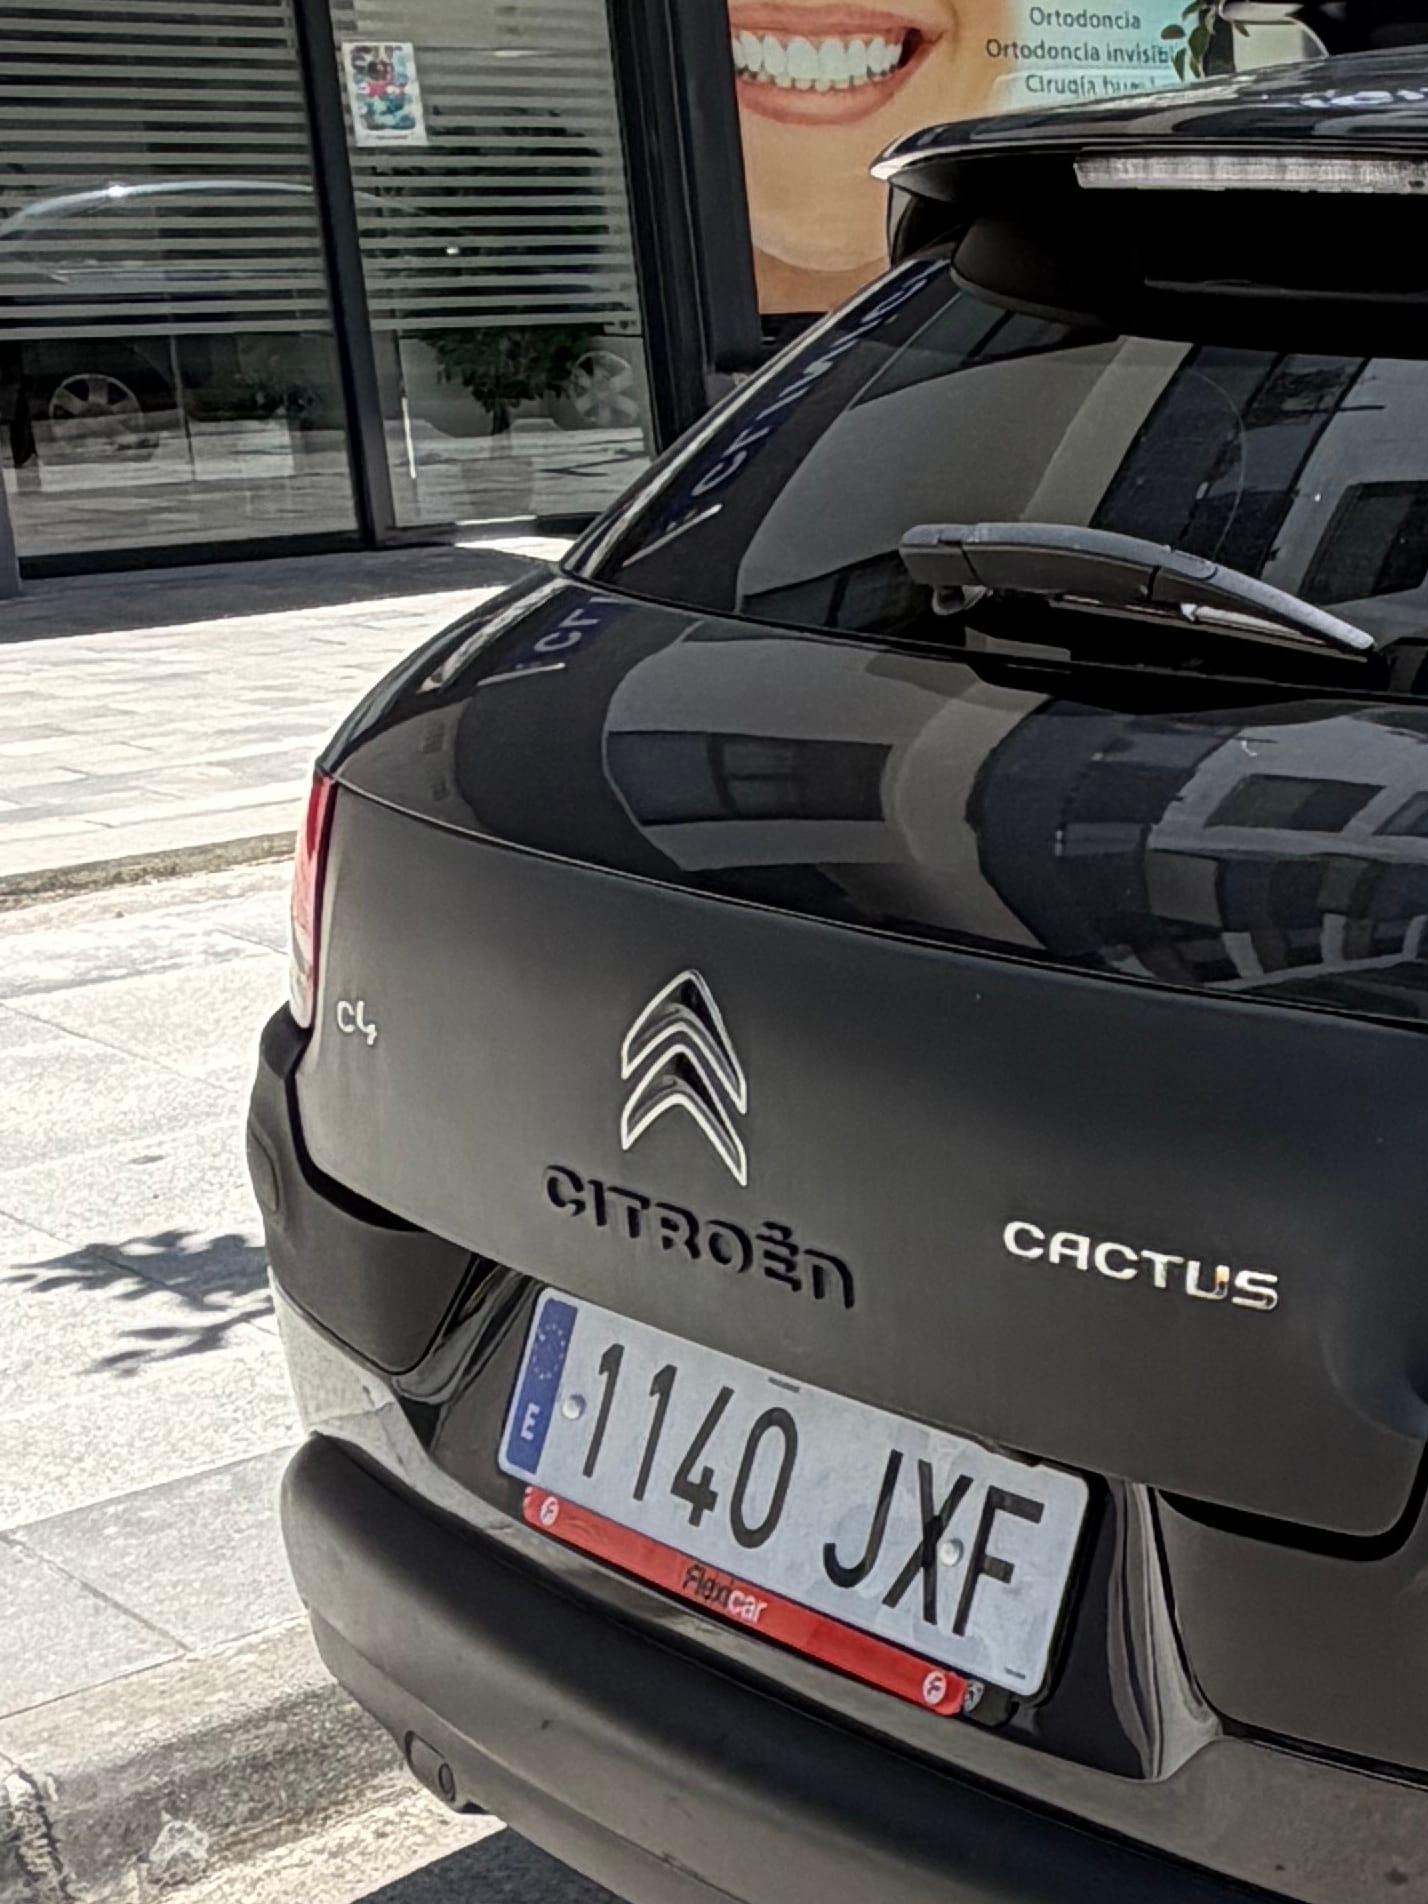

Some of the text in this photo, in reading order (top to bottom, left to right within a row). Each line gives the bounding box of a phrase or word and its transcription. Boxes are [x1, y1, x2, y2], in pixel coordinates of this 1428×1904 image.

[1029, 6, 1142, 30] Ortodoncia
[985, 38, 1100, 62] Ortodoncia
[336, 1000, 378, 1046] C4
[545, 1163, 855, 1309] CITROËN
[1003, 1220, 1279, 1312] CACTUS
[519, 1403, 541, 1442] E
[582, 1323, 1045, 1636] 1140 JXF
